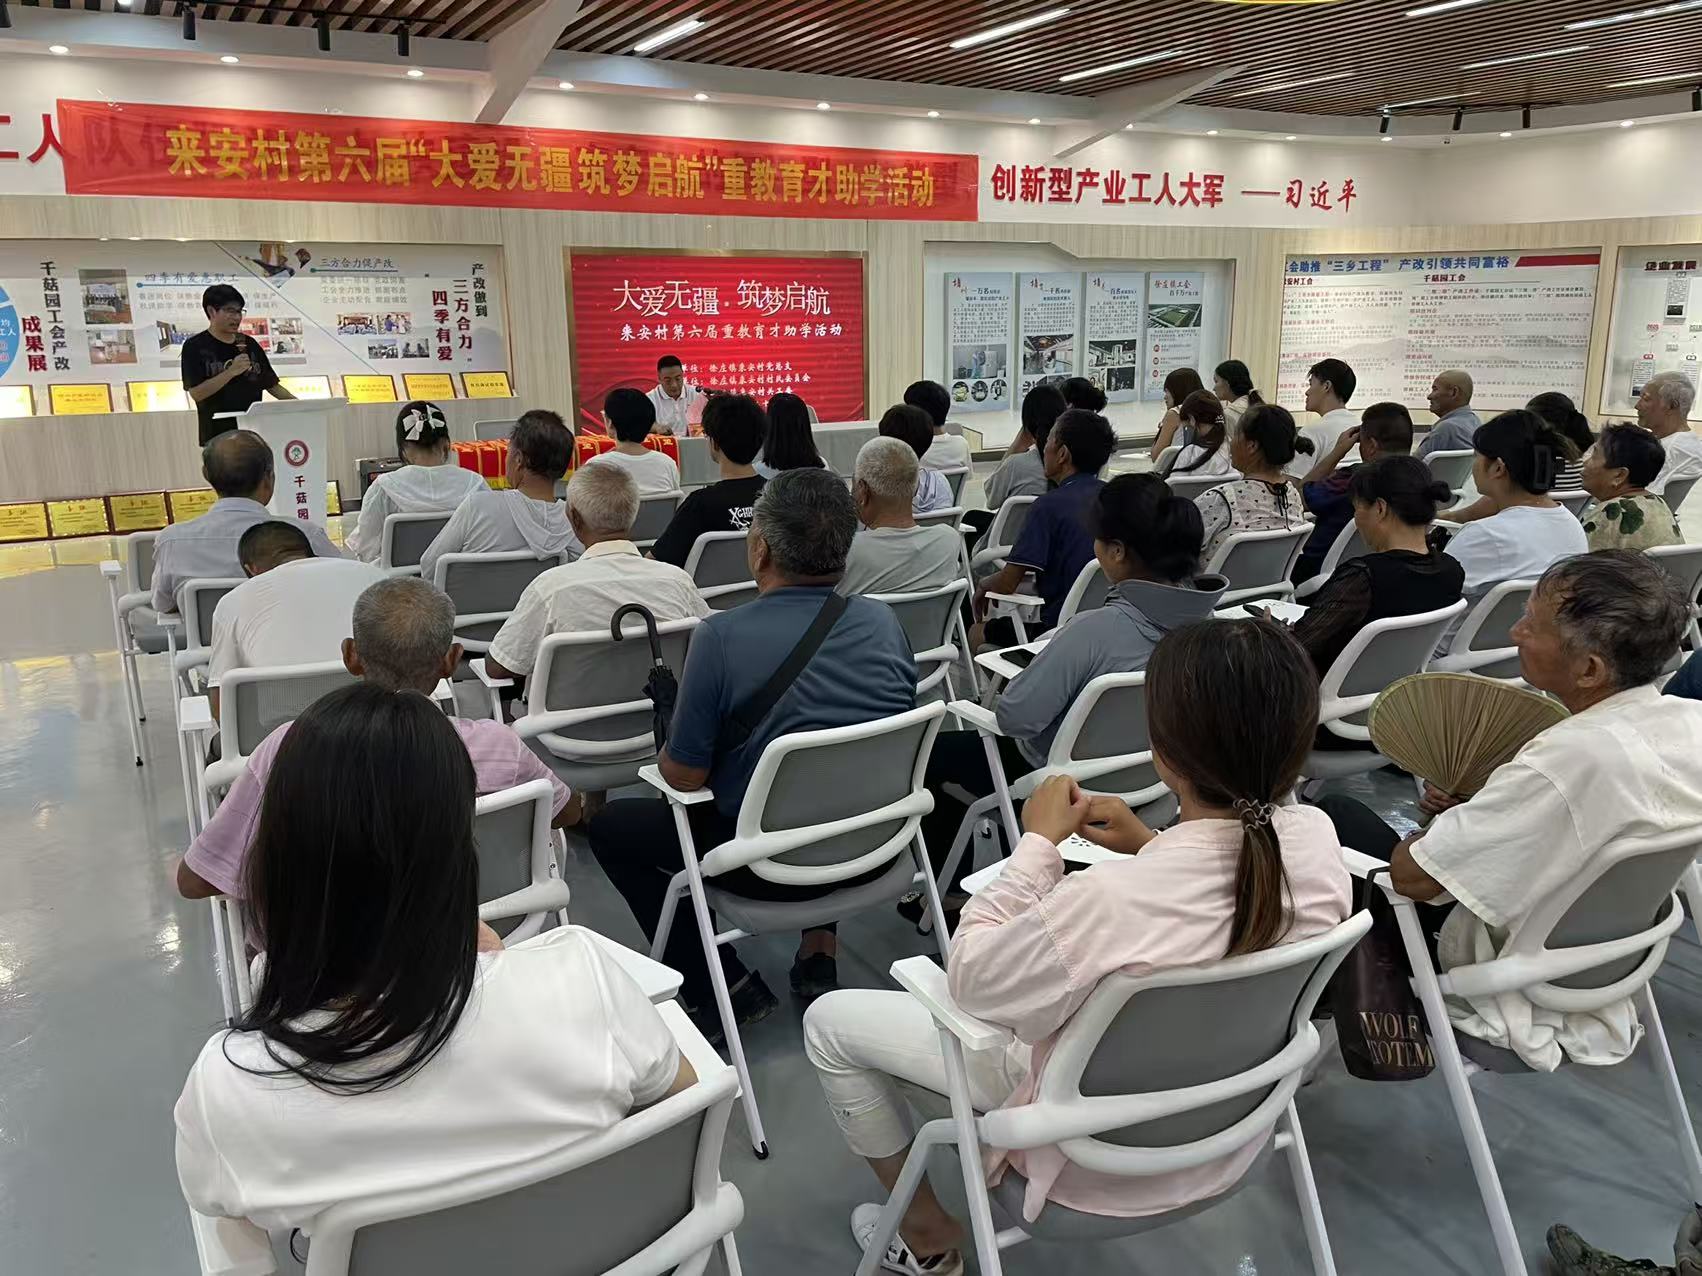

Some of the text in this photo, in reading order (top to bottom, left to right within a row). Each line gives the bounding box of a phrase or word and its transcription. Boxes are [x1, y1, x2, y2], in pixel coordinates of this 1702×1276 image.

[990, 163, 1225, 209] 创新型产业工人大军
[1398, 256, 1510, 271] 产改引领共同富裕
[471, 262, 488, 318] 产改做到
[40, 260, 71, 371] 千菇园工会产改
[620, 323, 844, 342] 来安村第六届重教育才助学活动
[22, 315, 48, 372] 成果展
[1360, 1011, 1419, 1039] WOLF
